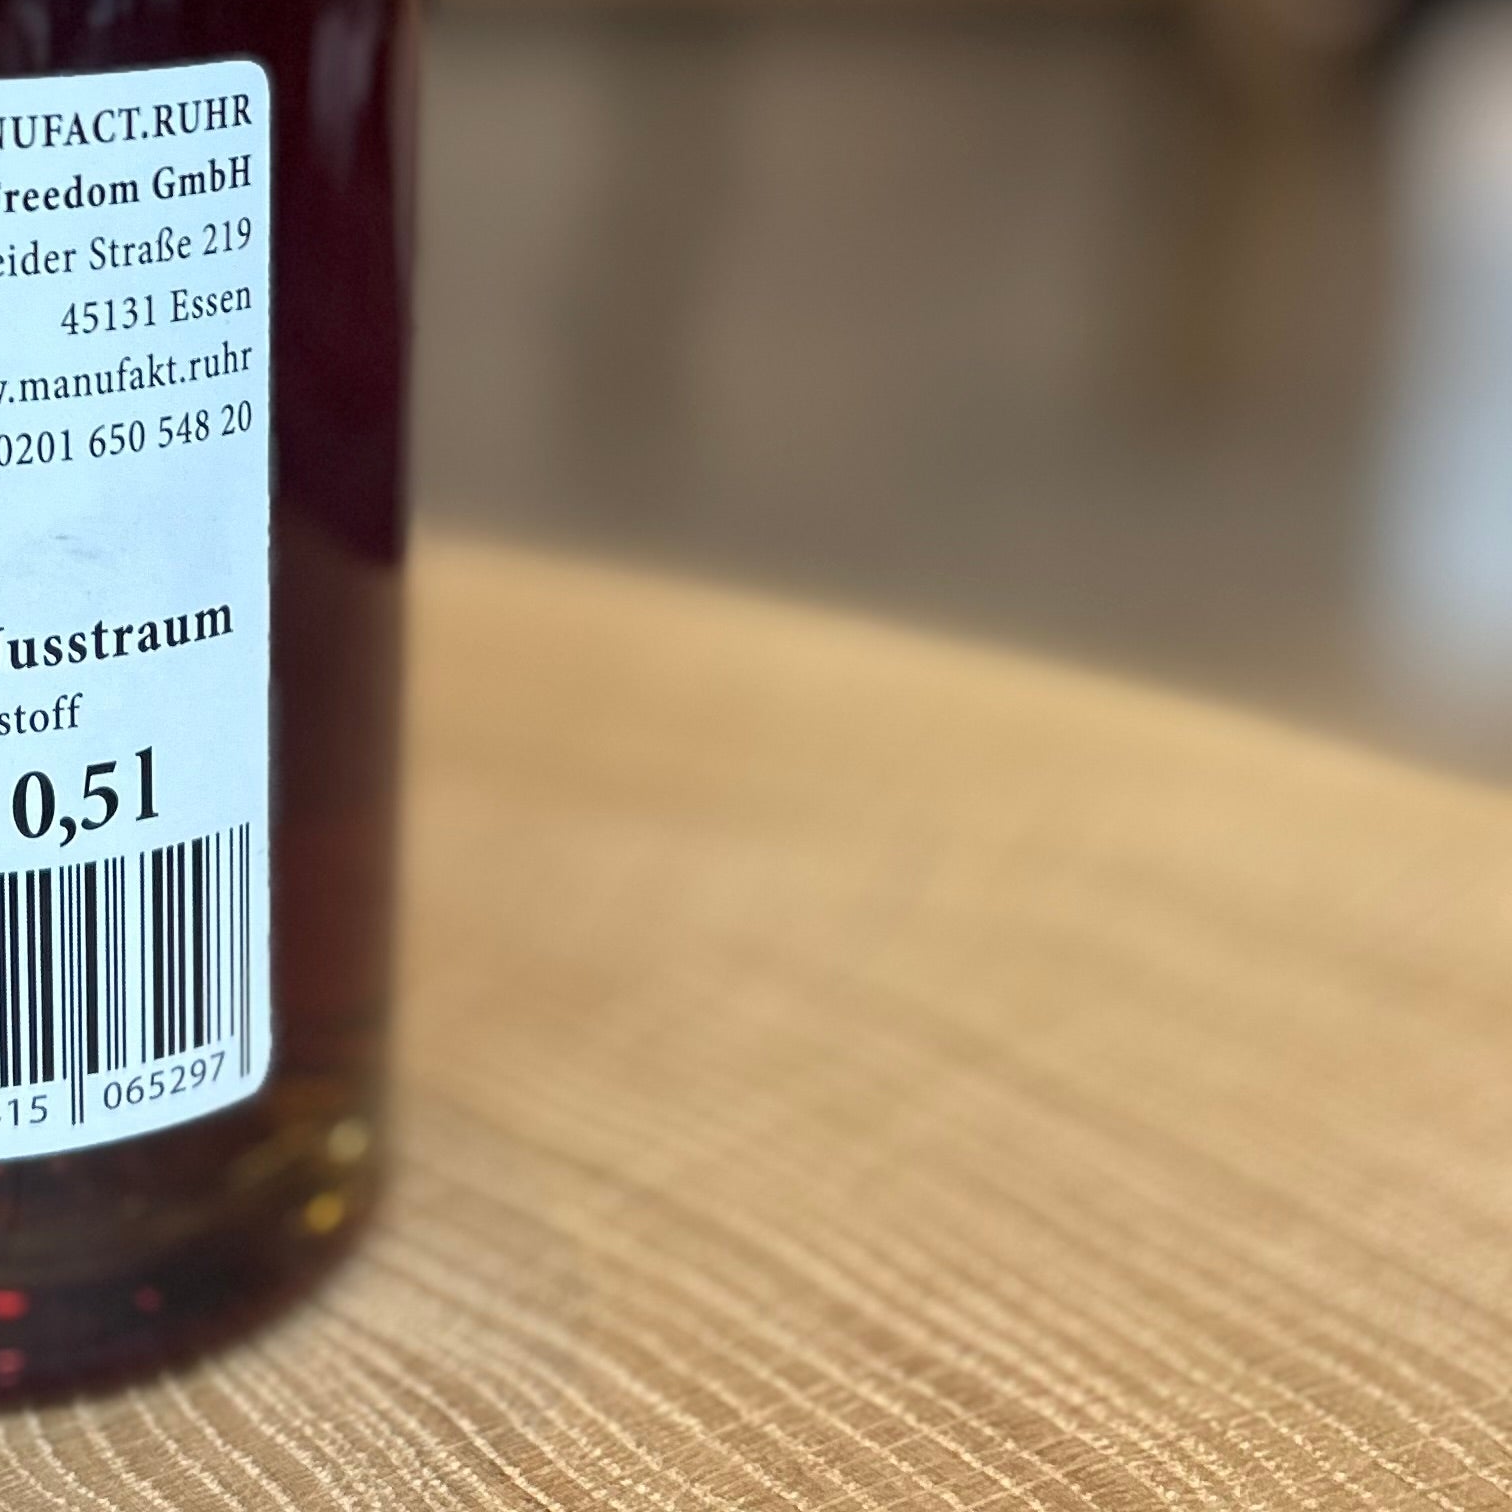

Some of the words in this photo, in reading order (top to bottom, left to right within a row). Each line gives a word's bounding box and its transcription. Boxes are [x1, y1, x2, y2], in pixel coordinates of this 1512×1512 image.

[151, 153, 253, 200] GmbH
[89, 226, 192, 272] Straße
[202, 215, 253, 256] 219
[60, 294, 158, 336] 45131
[170, 286, 253, 324] Essen
[88, 419, 146, 458] 650
[157, 408, 211, 449] 548
[220, 399, 253, 437] 20
[103, 1051, 227, 1110] 065297
